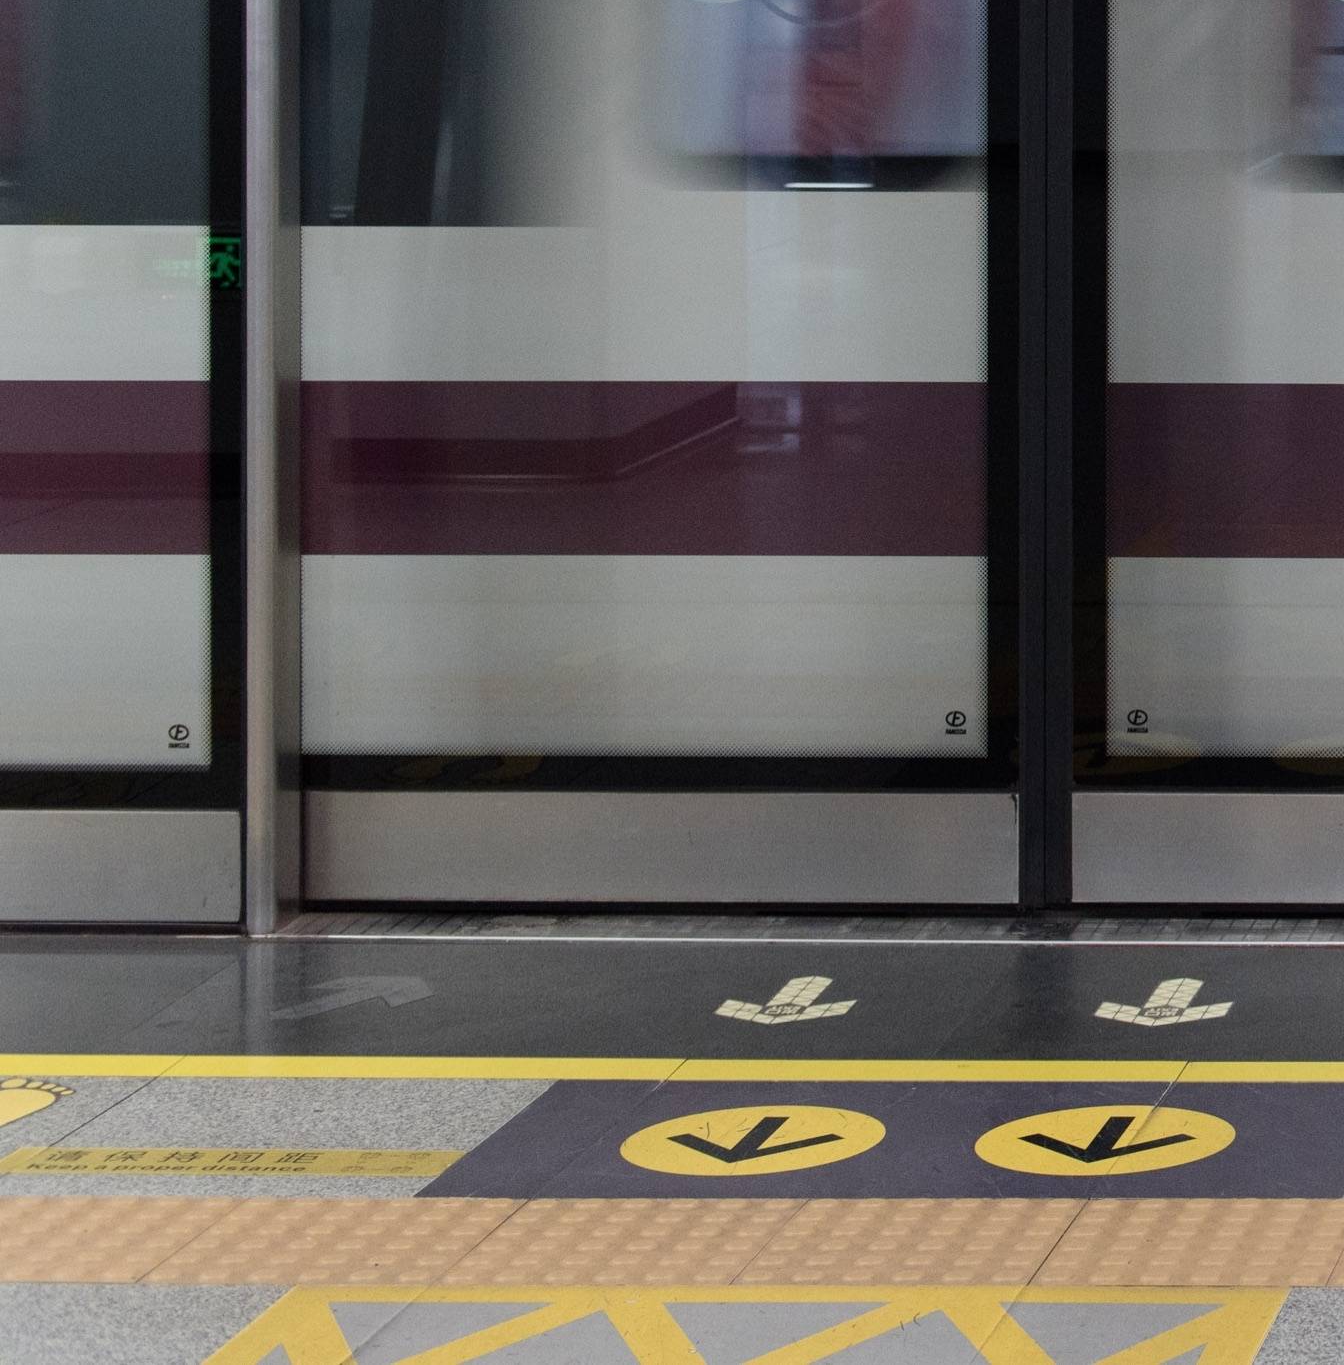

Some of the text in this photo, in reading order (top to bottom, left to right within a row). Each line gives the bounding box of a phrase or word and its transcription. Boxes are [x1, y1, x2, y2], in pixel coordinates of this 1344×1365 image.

[46, 1150, 325, 1164] 请保持间距
[26, 1163, 306, 1172] Keep a proper distance
